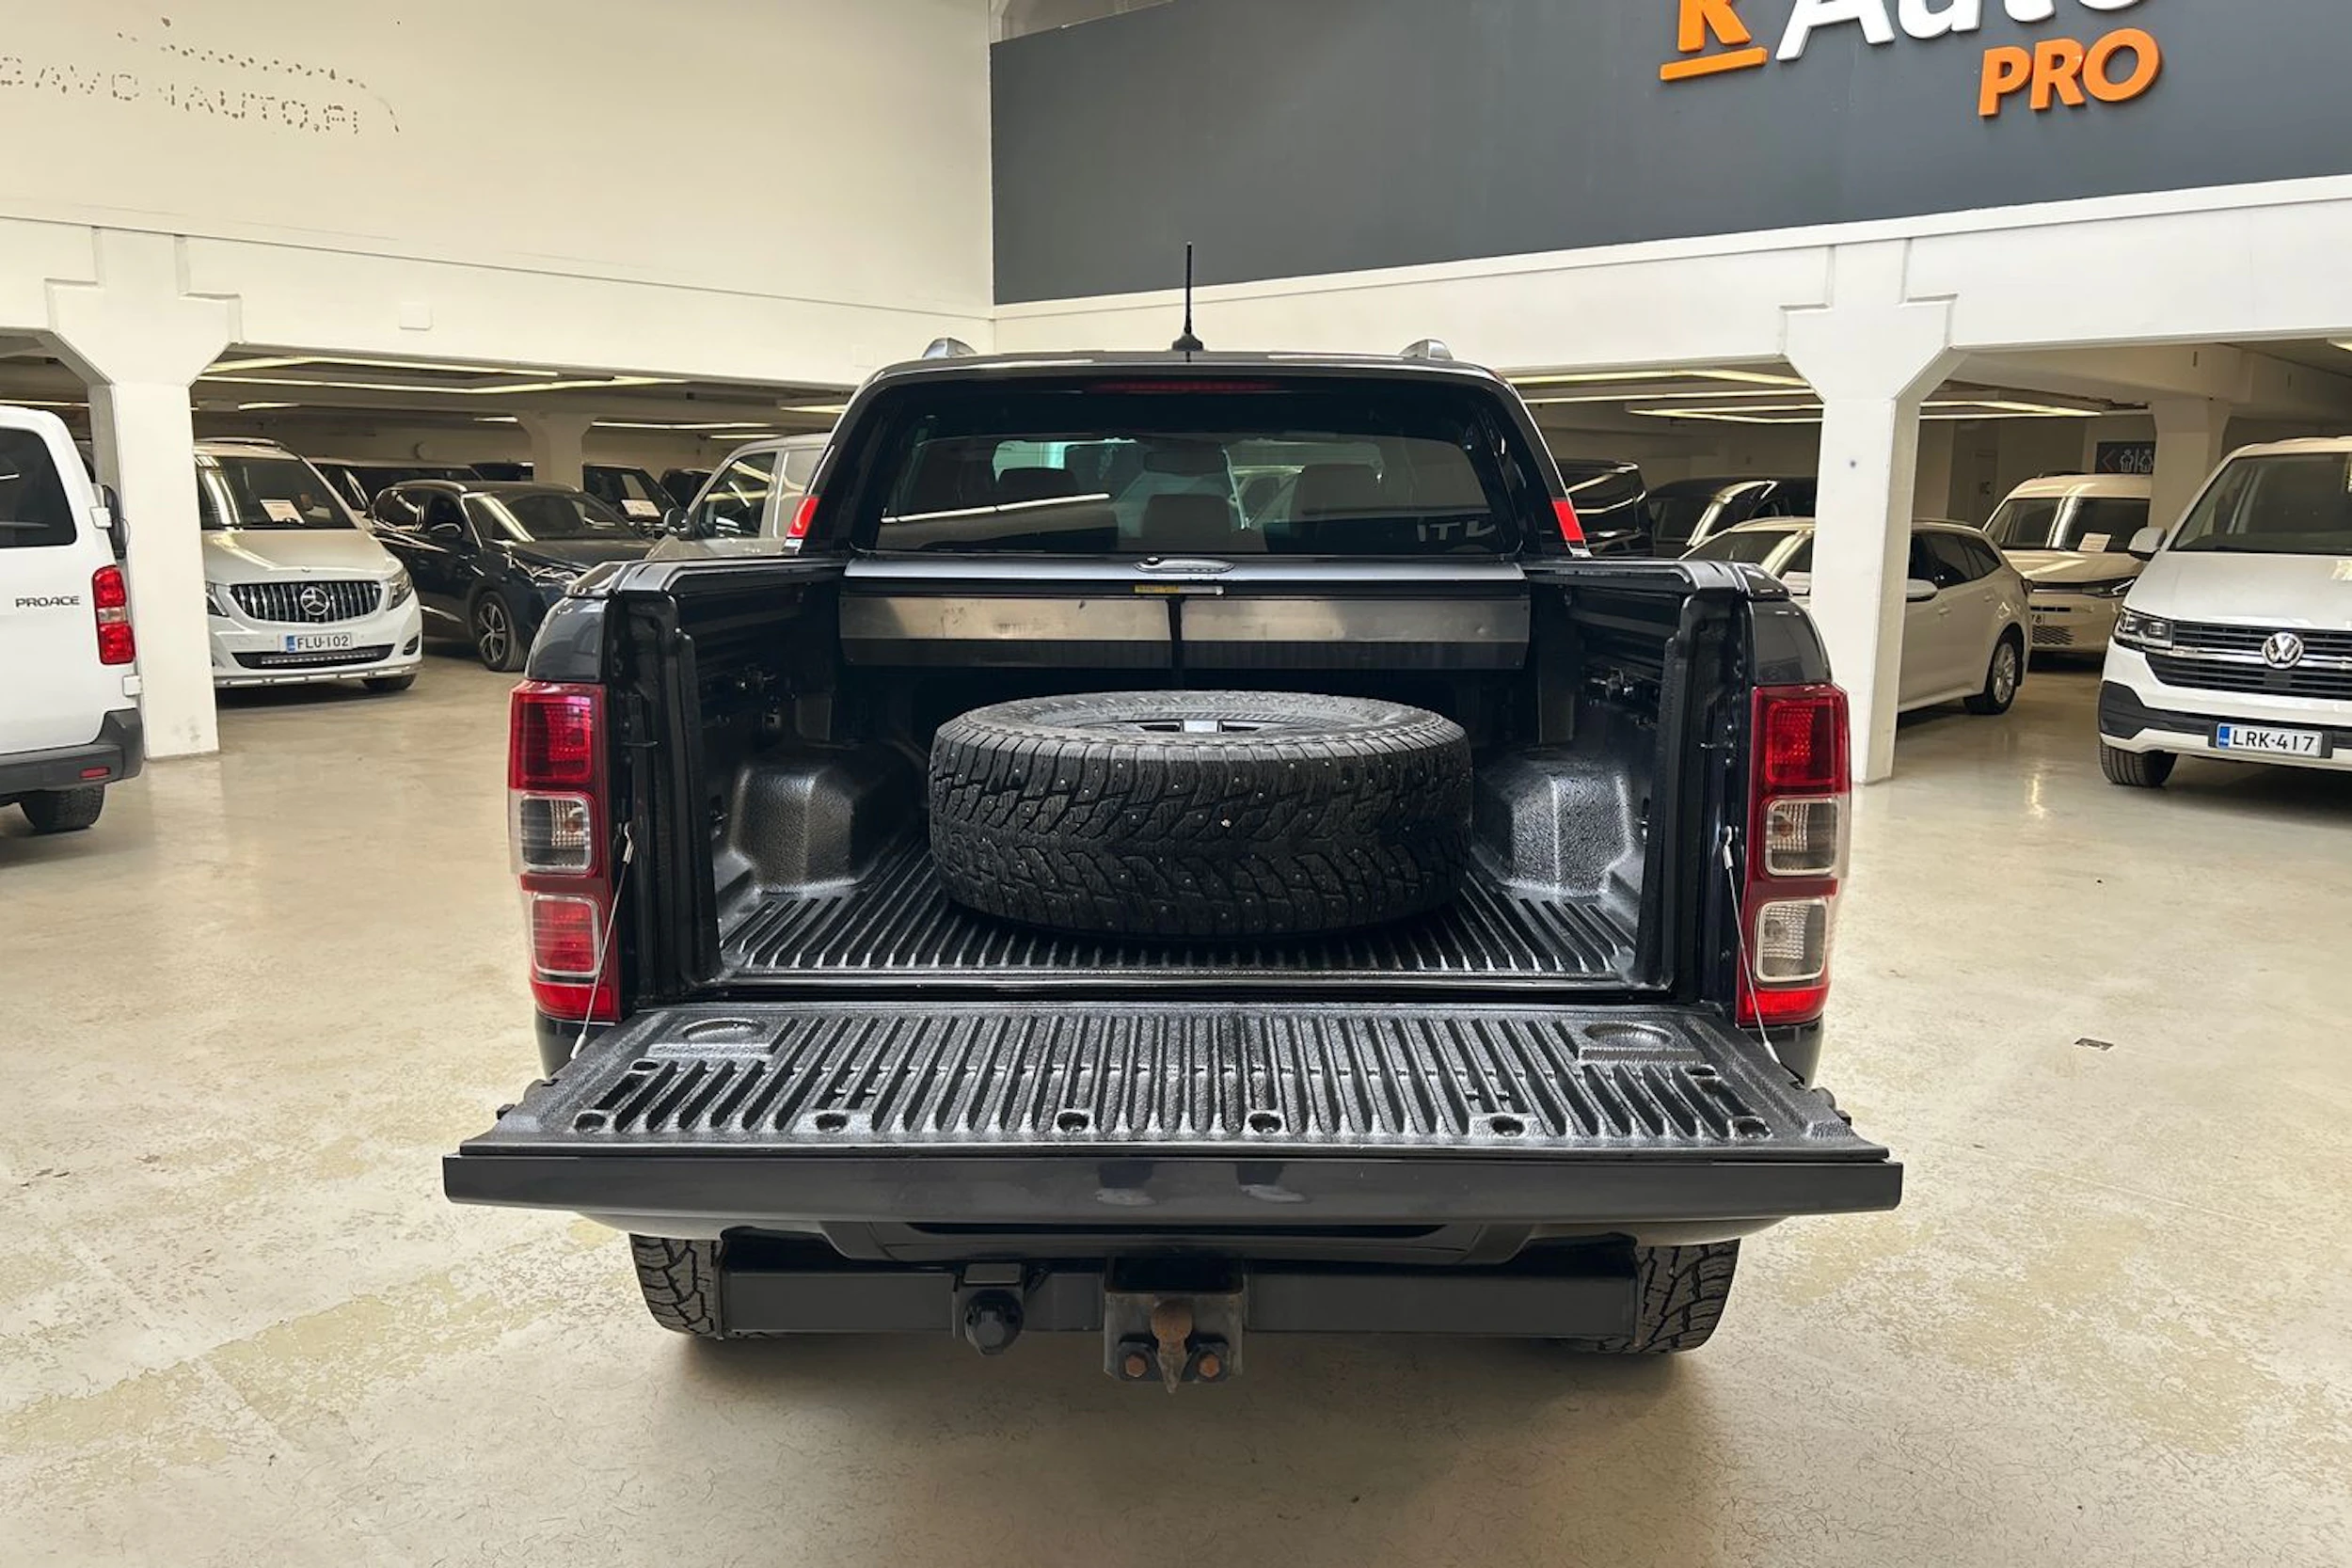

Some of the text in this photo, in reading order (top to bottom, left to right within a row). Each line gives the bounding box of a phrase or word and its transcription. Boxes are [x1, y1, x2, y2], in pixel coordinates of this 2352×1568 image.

[1979, 27, 2161, 118] PRO
[15, 595, 81, 608] PROACE
[296, 635, 349, 649] FLU-102
[2233, 730, 2314, 751] LRK-417
